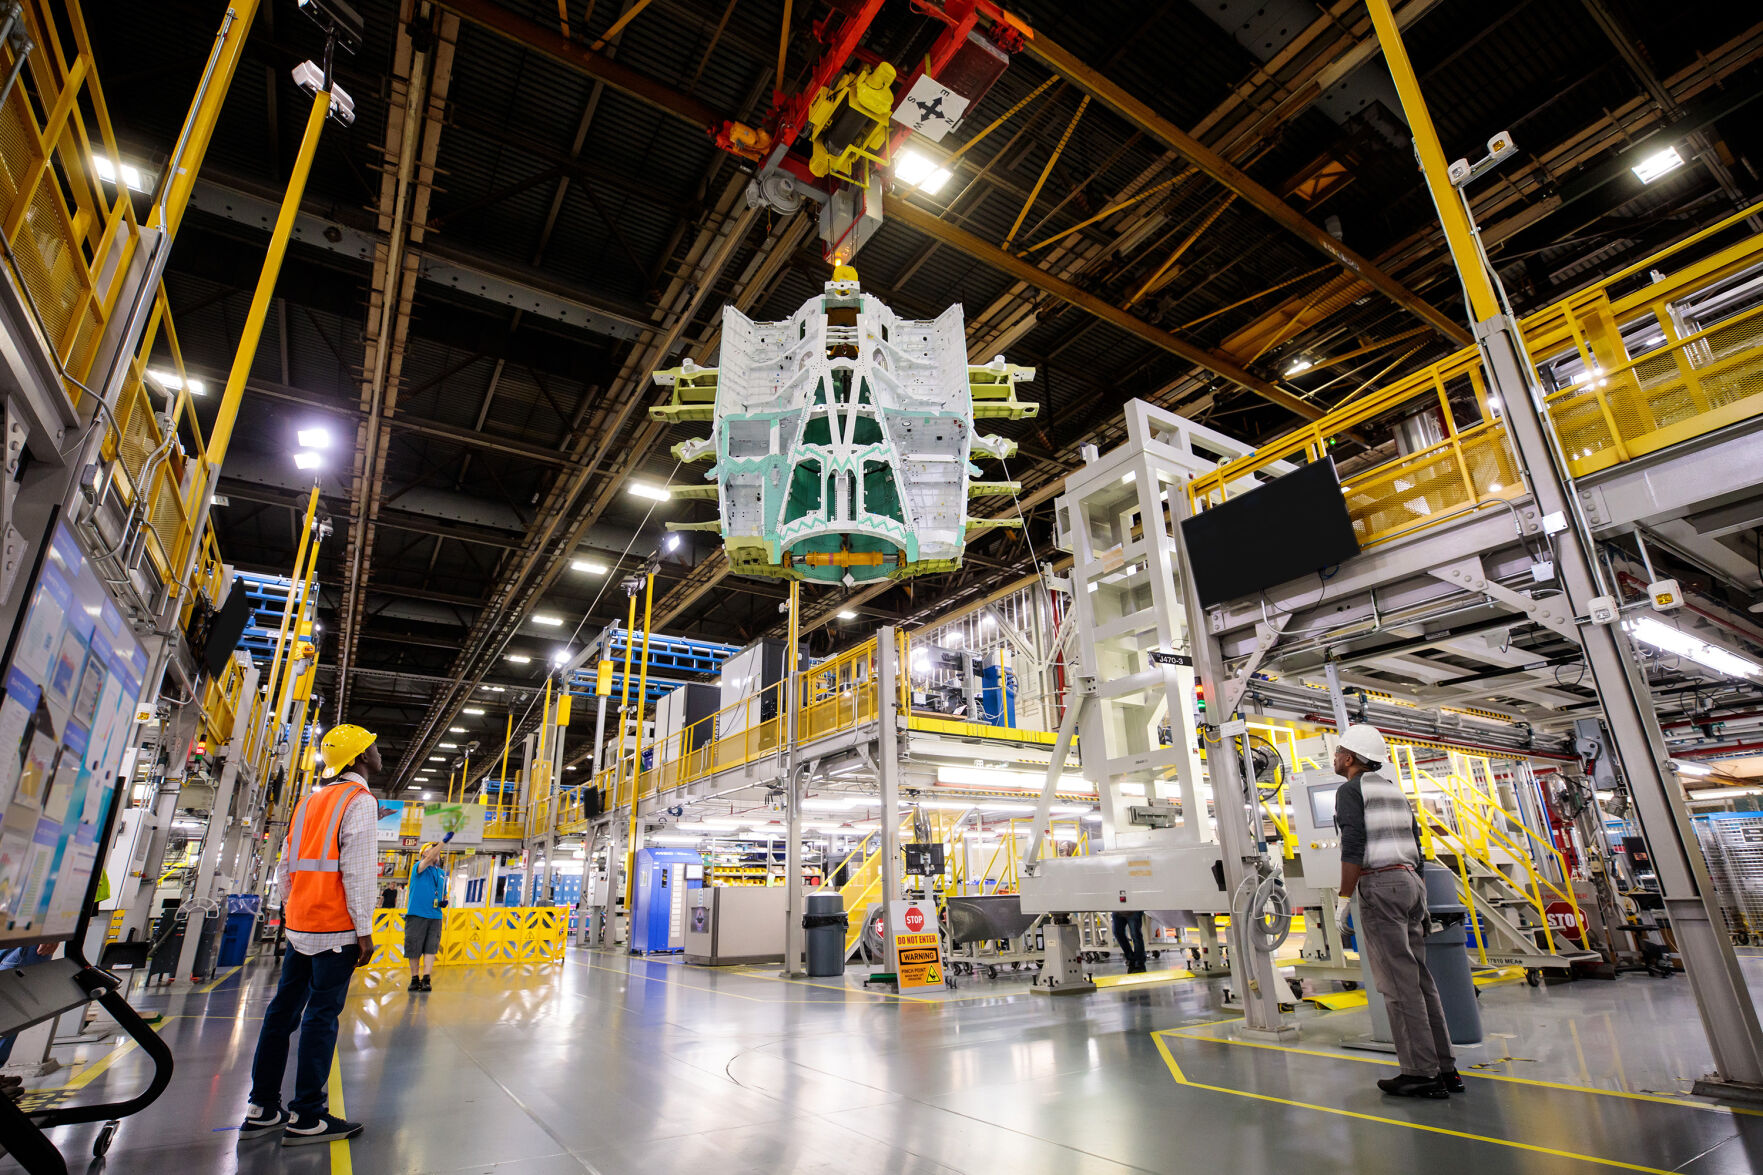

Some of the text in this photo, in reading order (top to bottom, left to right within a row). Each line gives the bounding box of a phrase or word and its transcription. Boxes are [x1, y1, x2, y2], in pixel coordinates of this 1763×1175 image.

[940, 89, 950, 97] E
[907, 96, 916, 104] S
[945, 117, 954, 125] N
[913, 122, 924, 130] W
[1160, 656, 1184, 665] J470-3
[405, 838, 414, 846] EXIT
[906, 915, 923, 925] STOP
[897, 934, 937, 945] DO NOT ENTER
[903, 951, 934, 961] WARNING
